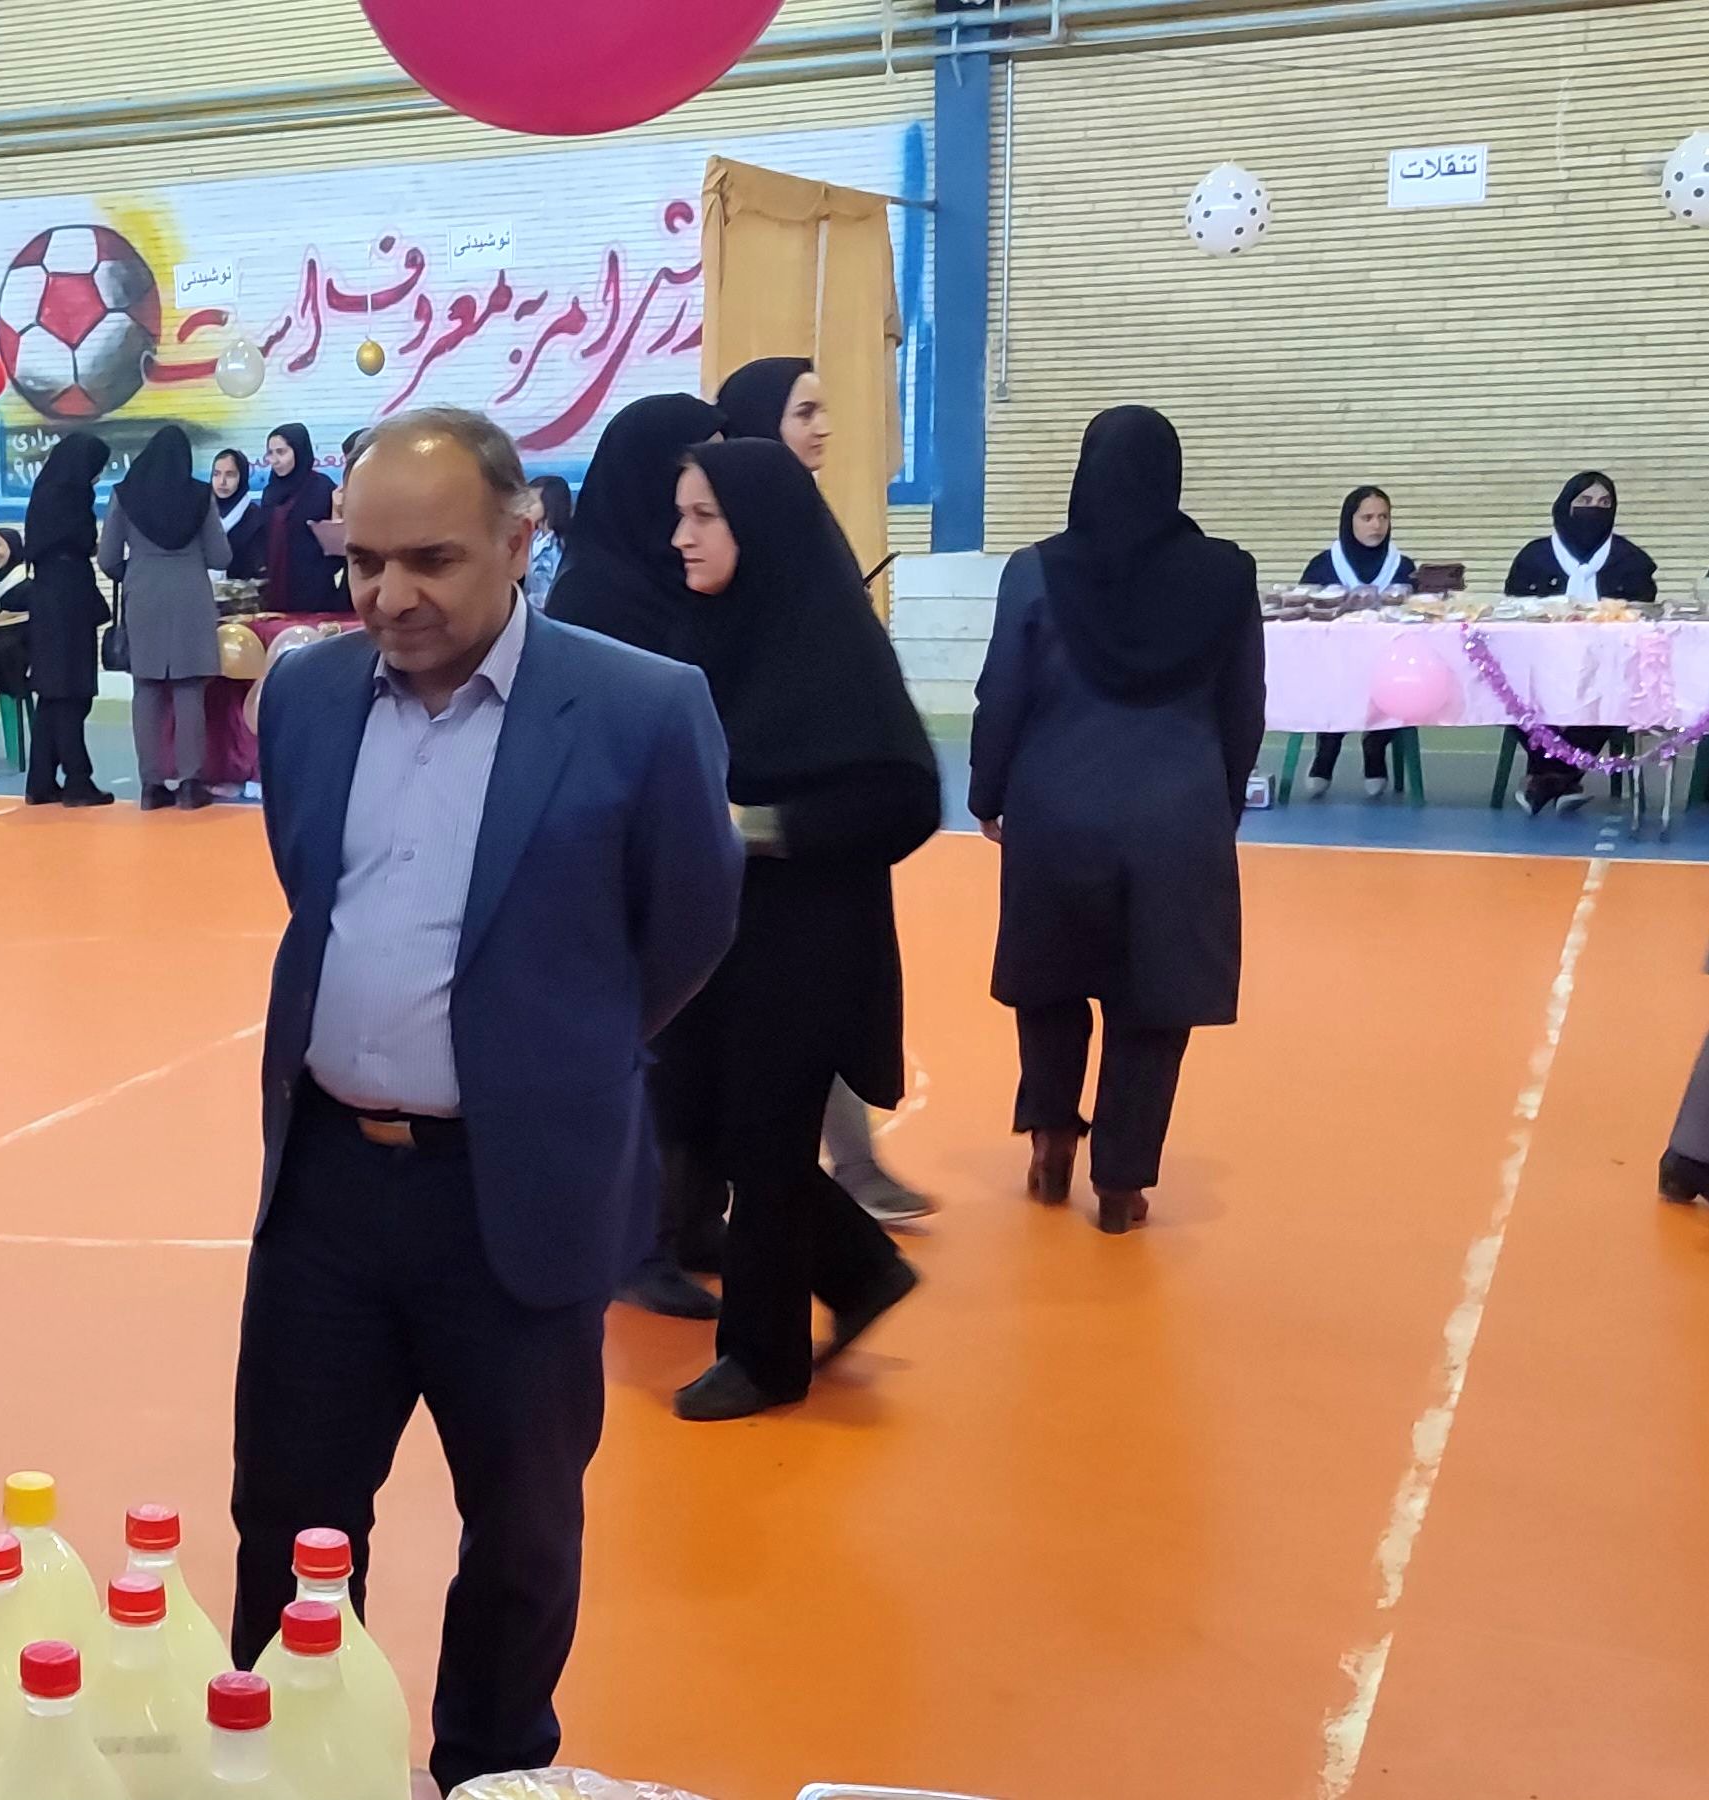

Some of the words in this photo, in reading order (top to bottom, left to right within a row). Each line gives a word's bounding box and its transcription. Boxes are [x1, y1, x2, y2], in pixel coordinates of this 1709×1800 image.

[1399, 154, 1477, 180] تنقلات
[453, 231, 510, 257] نوشیدنی
[181, 265, 231, 292] نوشیدنی
